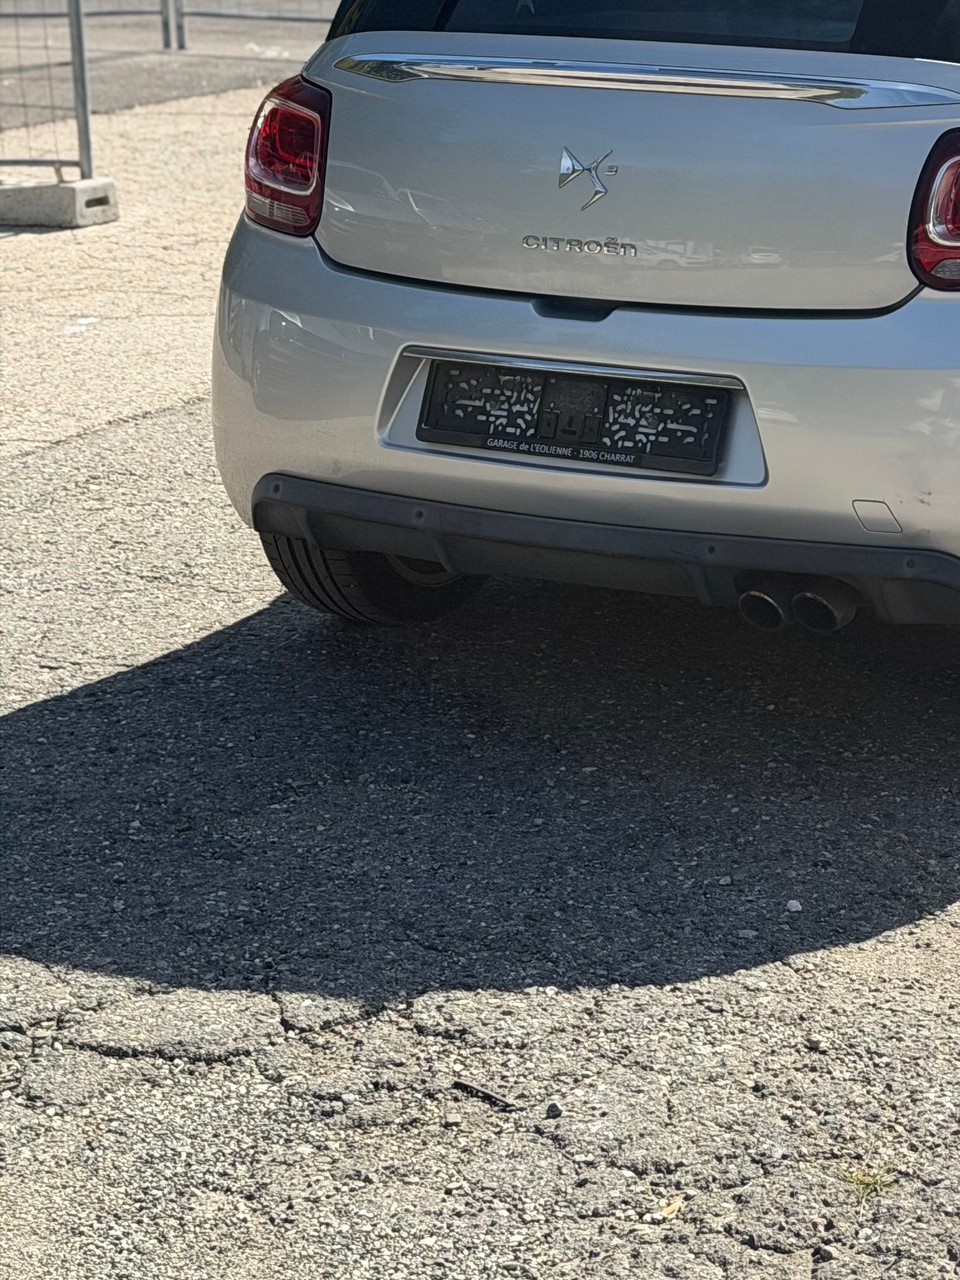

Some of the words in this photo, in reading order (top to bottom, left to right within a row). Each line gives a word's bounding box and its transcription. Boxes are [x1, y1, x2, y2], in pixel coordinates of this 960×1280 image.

[487, 438, 518, 449] GARAGE
[519, 442, 529, 451] de
[530, 444, 573, 456] L'EOLIENNE
[579, 449, 598, 459] 1906
[599, 452, 636, 463] CHARRAT
